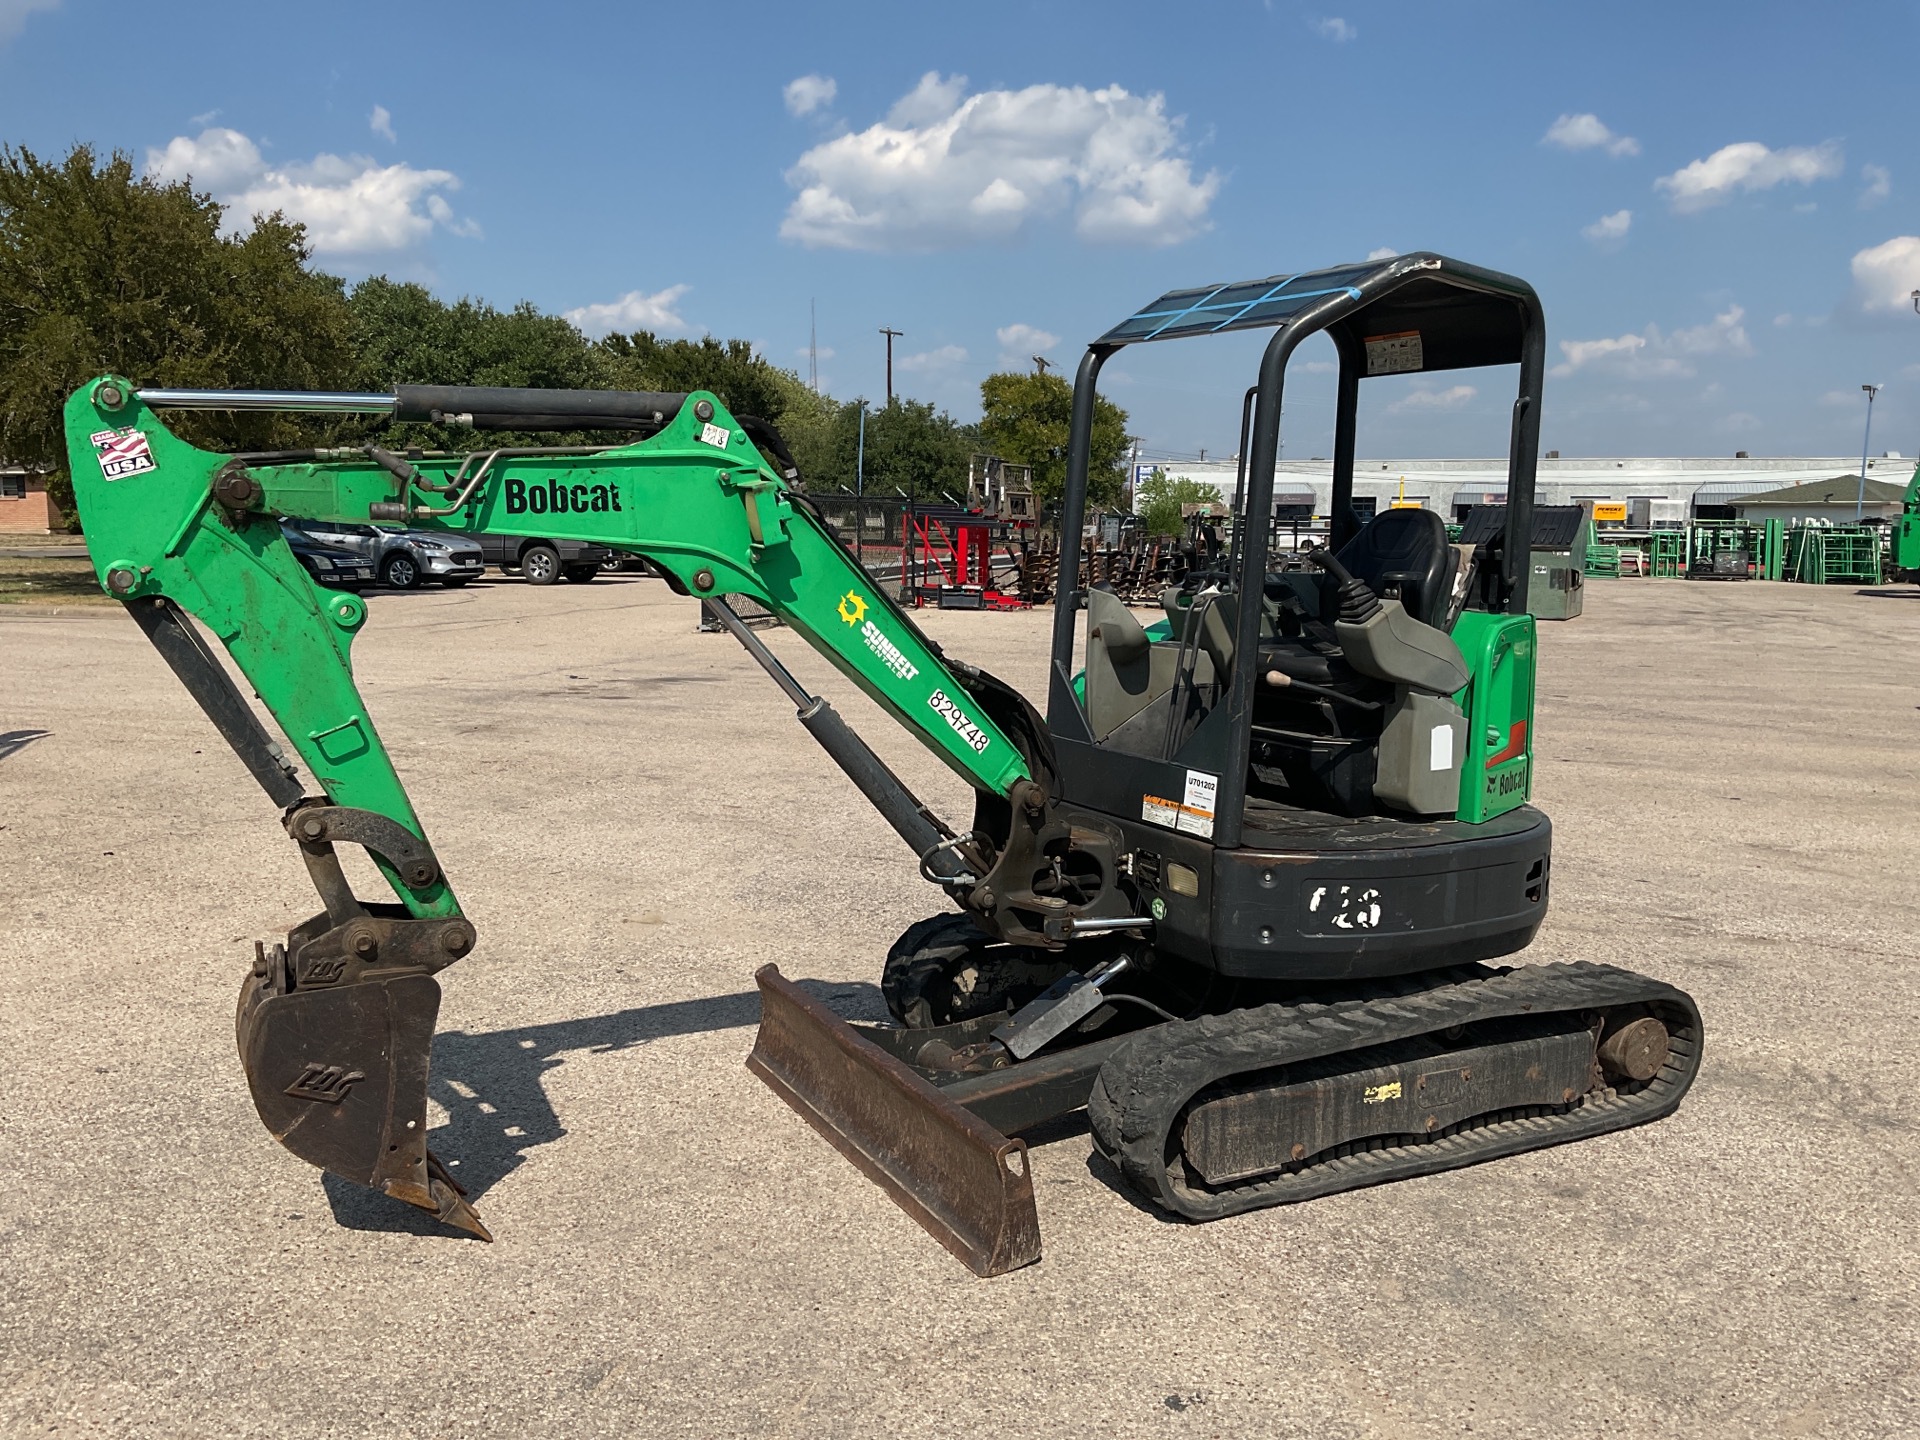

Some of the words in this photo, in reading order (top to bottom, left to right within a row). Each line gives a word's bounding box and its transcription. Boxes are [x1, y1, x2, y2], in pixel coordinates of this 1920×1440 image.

[94, 432, 115, 441] MADE
[105, 457, 151, 475] USA
[505, 478, 623, 514] Bobcat
[861, 620, 919, 681] SUNBELT
[863, 638, 904, 680] RENTALS
[930, 691, 988, 751] 829748
[1188, 777, 1216, 791] U701202
[1500, 766, 1526, 796] Bobcat
